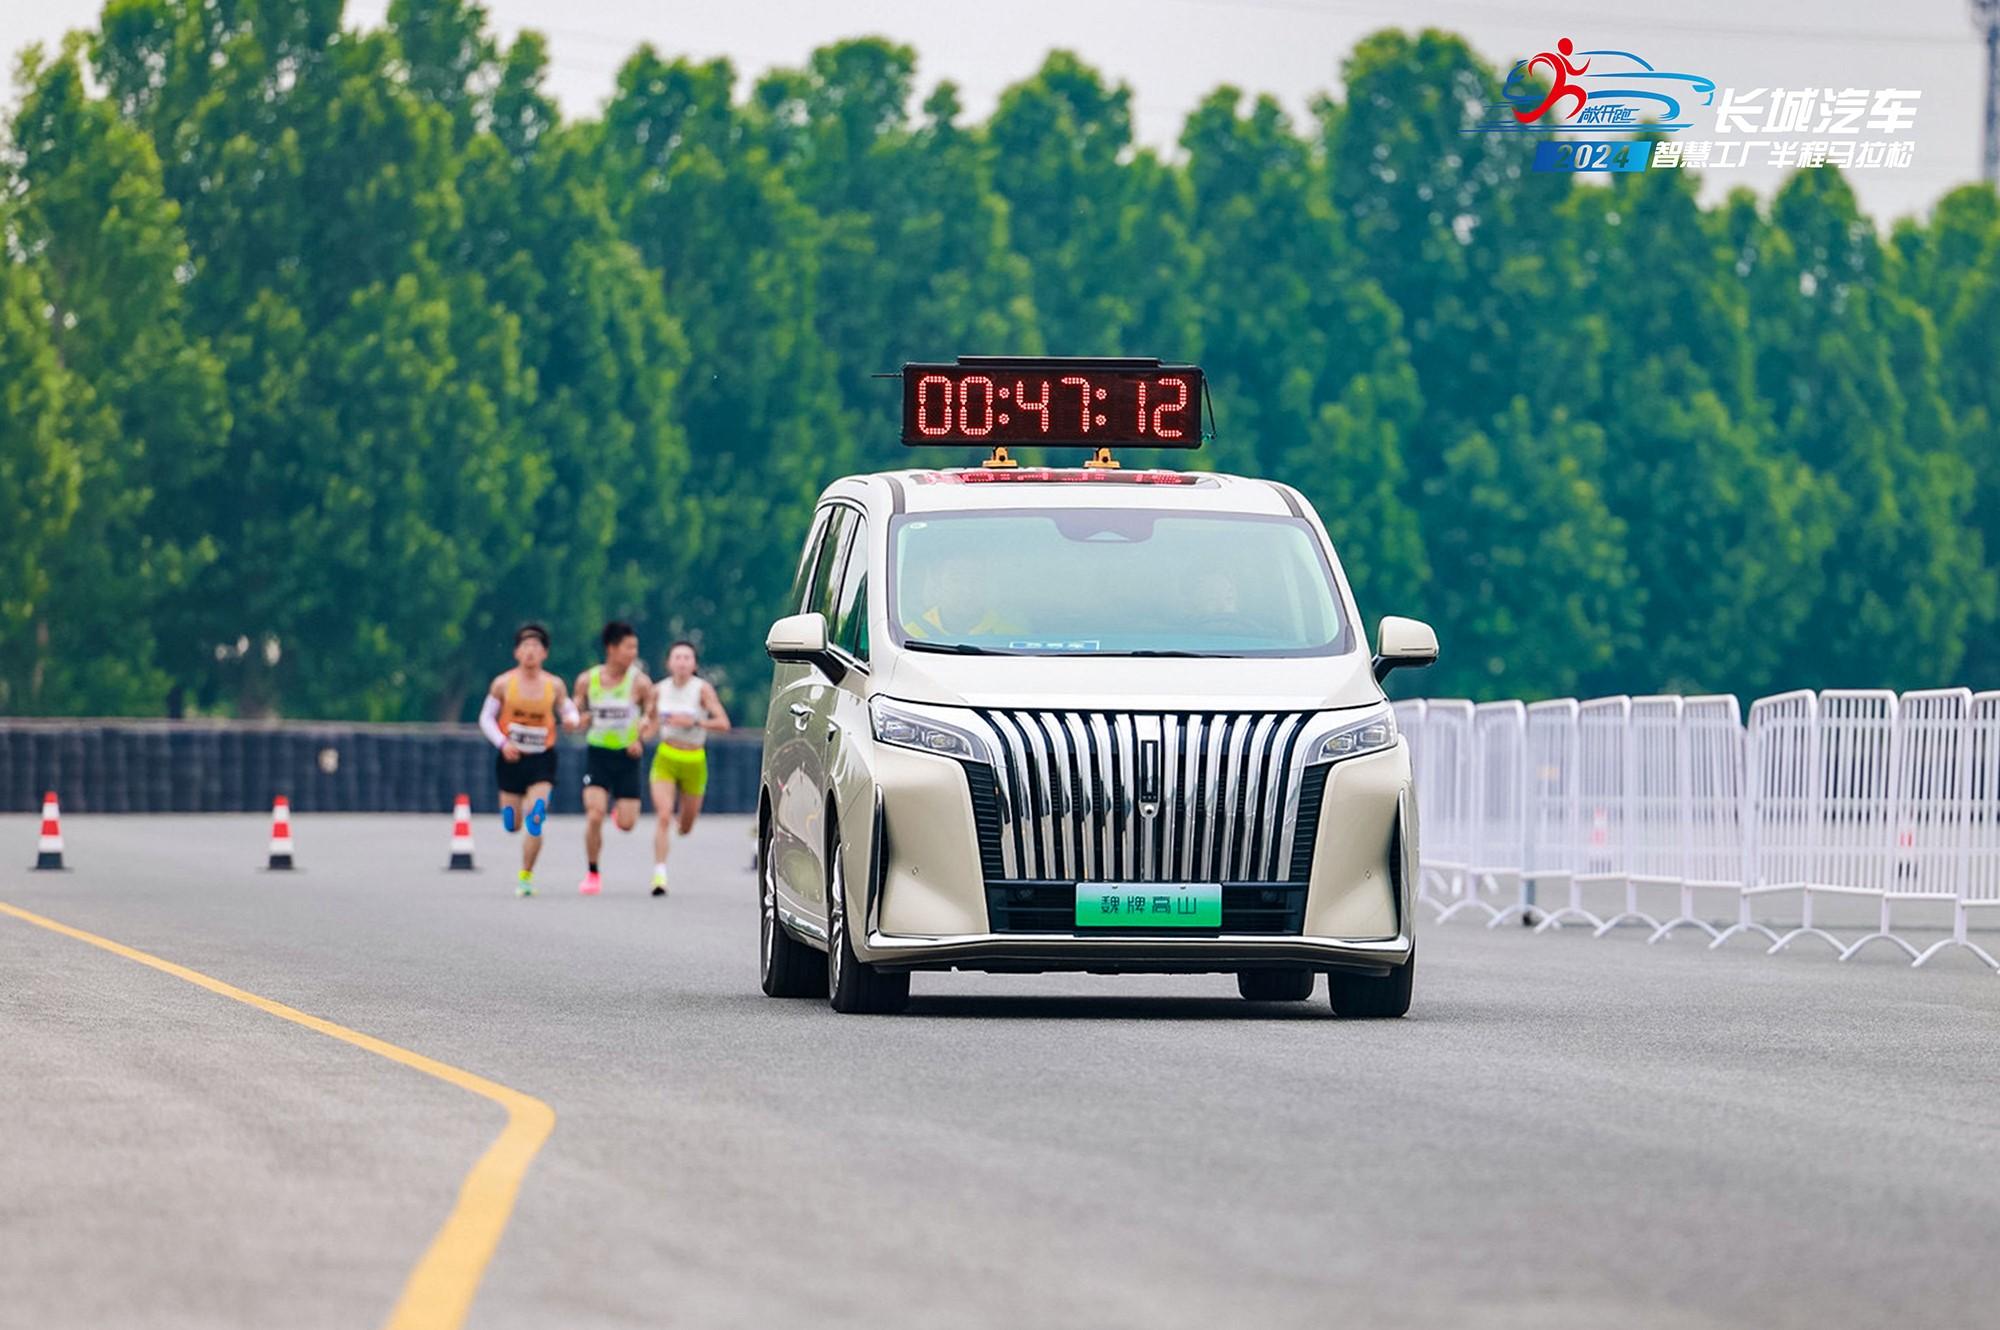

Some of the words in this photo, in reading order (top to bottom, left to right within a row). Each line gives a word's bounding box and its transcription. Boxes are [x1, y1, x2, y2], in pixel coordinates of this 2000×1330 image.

[918, 375, 1187, 437] 00:47:12
[1101, 895, 1197, 915] 魏牌高山
